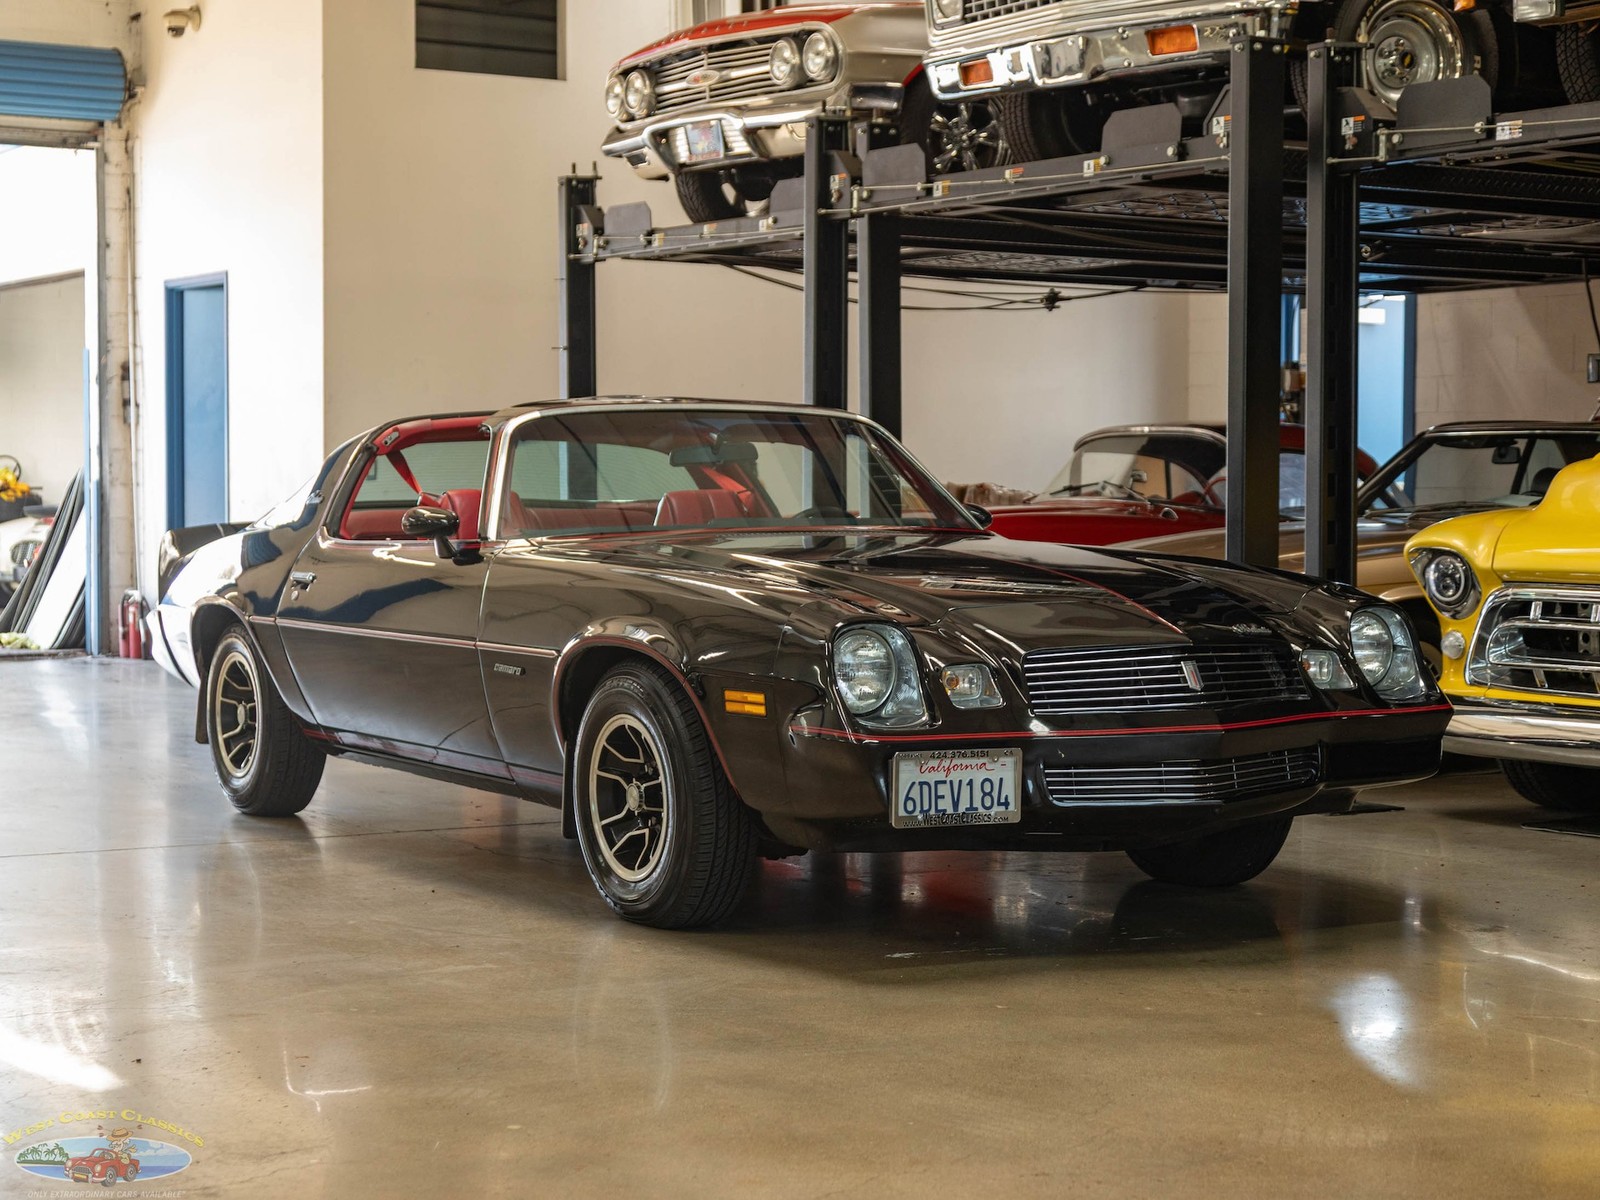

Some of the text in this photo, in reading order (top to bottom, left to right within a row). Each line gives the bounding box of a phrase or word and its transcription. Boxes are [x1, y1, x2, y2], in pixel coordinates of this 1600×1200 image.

[930, 750, 990, 759] 424.376.5151
[920, 758, 995, 778] California
[903, 777, 1010, 815] 6DEV184
